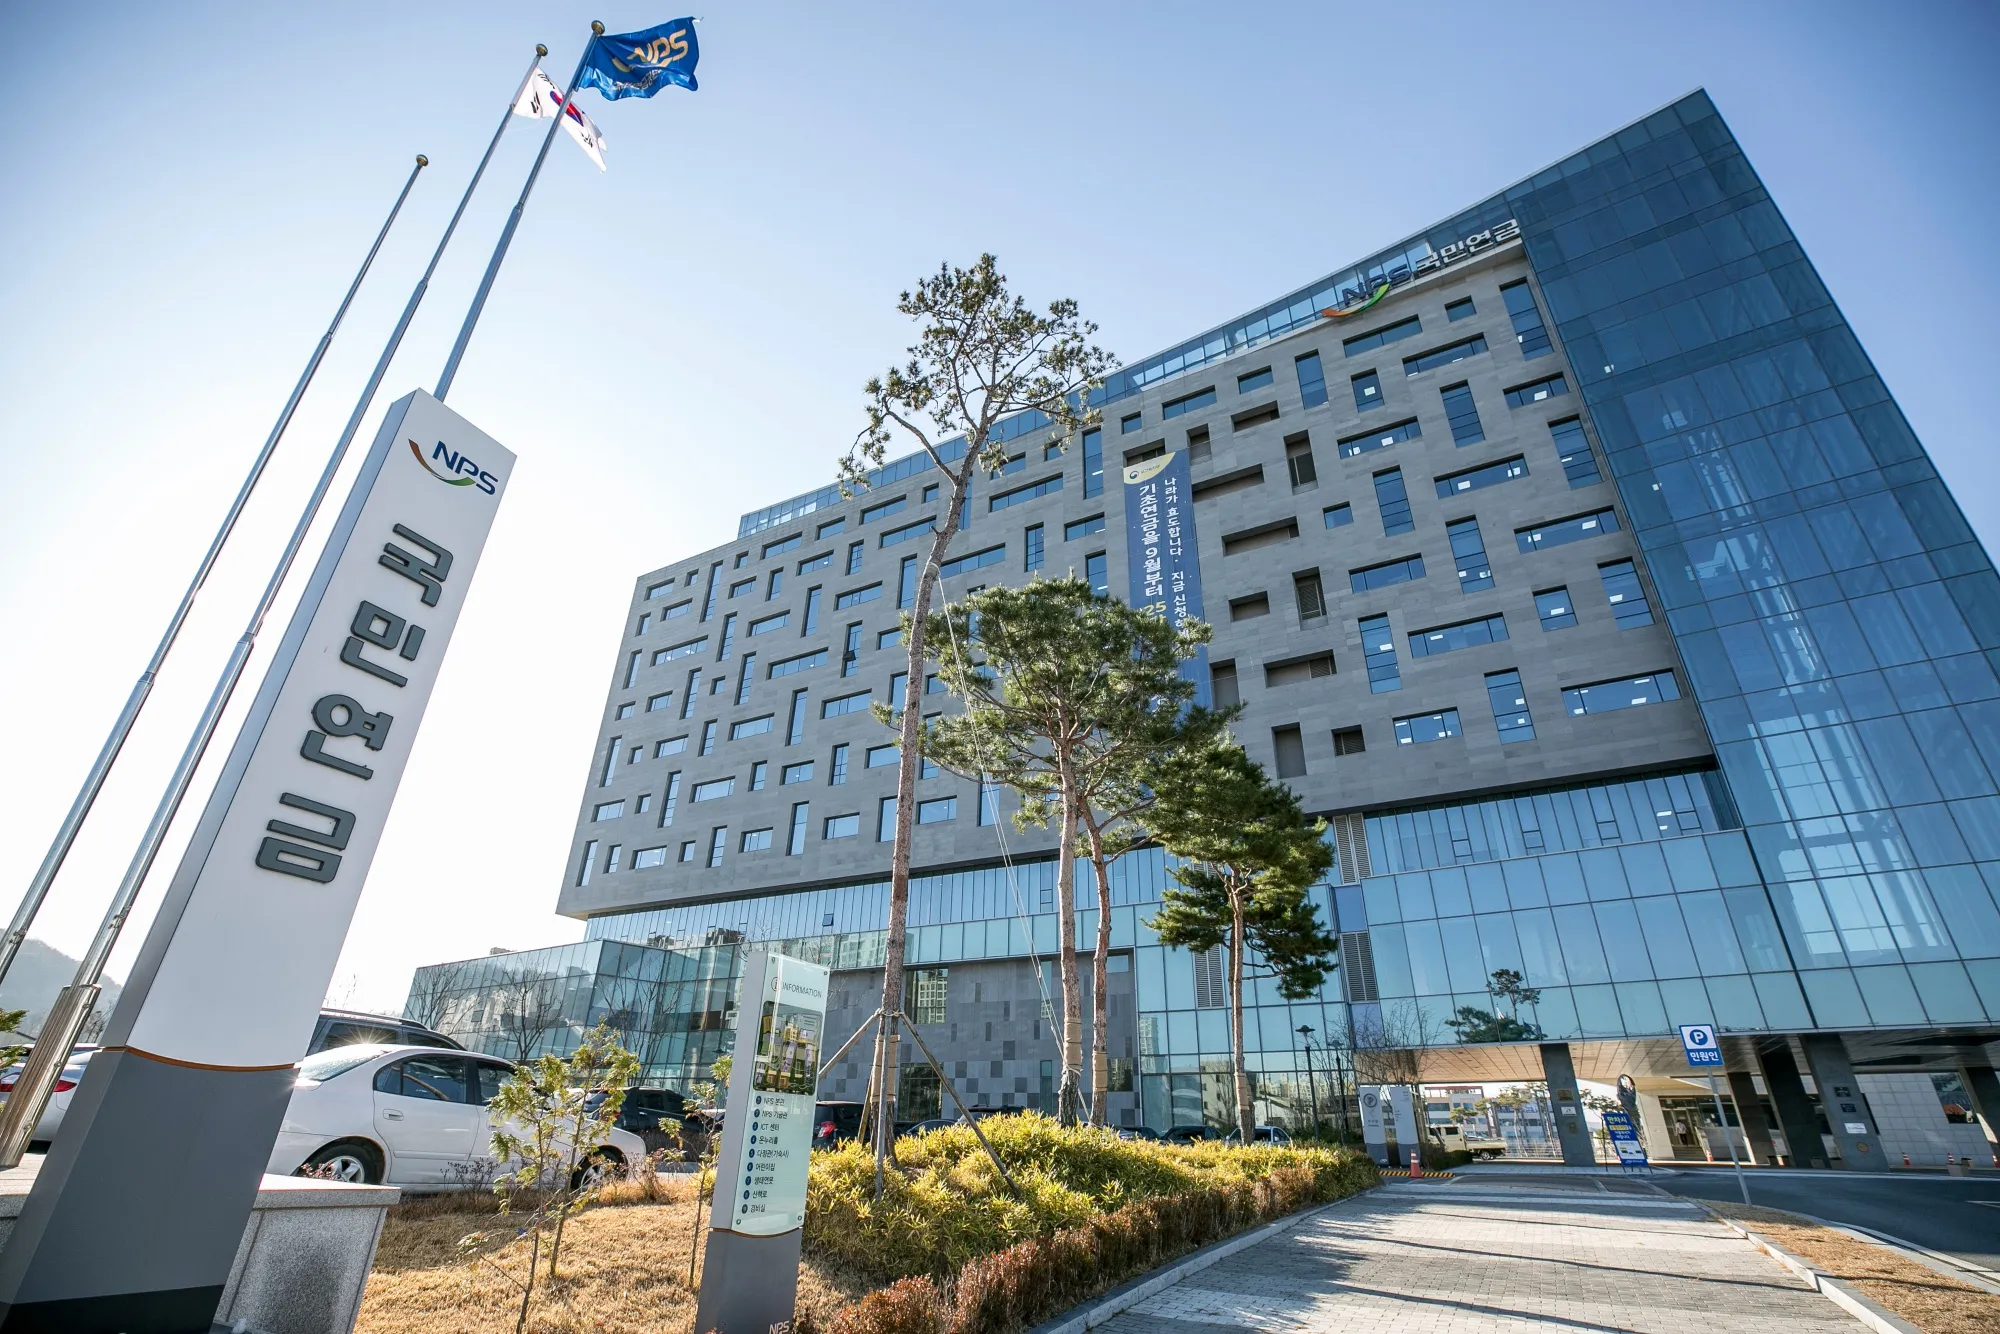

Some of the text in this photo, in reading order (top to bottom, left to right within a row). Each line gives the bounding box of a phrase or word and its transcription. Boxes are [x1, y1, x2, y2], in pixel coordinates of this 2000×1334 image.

[1341, 218, 1521, 306] NPS 국민연금
[432, 440, 499, 496] NPS
[1139, 482, 1161, 546] 기초연금을
[1164, 477, 1178, 504] 나라가
[1171, 571, 1185, 592] 지금
[1144, 547, 1163, 597] 9월부터
[255, 522, 454, 884] 국민연금
[782, 982, 822, 998] INFORMATION
[1693, 1031, 1704, 1043] P
[1690, 1051, 1719, 1062] 민원인
[762, 1110, 773, 1118] NPS
[760, 1123, 780, 1132] ICT 센터
[755, 1163, 776, 1172] 어린이집
[752, 1190, 767, 1199] 산책로
